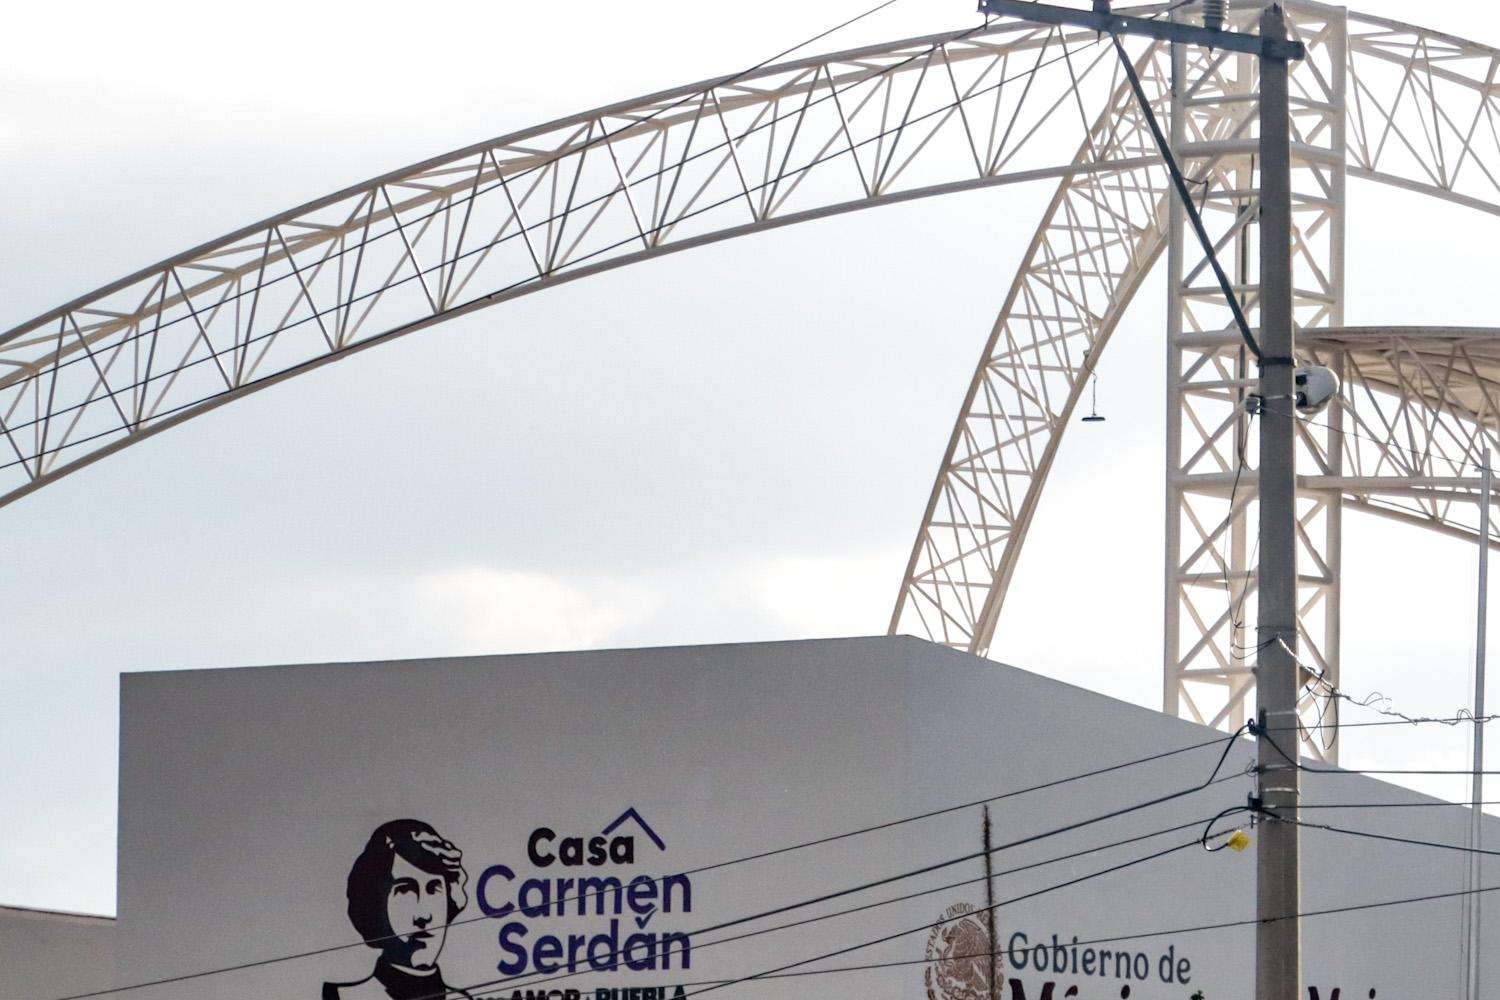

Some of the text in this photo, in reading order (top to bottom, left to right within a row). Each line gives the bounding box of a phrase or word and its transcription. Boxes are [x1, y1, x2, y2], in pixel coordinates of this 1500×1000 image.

[527, 827, 635, 868] Casa
[476, 864, 692, 919] Carmen
[497, 918, 691, 976] Serdán
[1008, 931, 1150, 981] Gobierno
[1158, 945, 1191, 985] de
